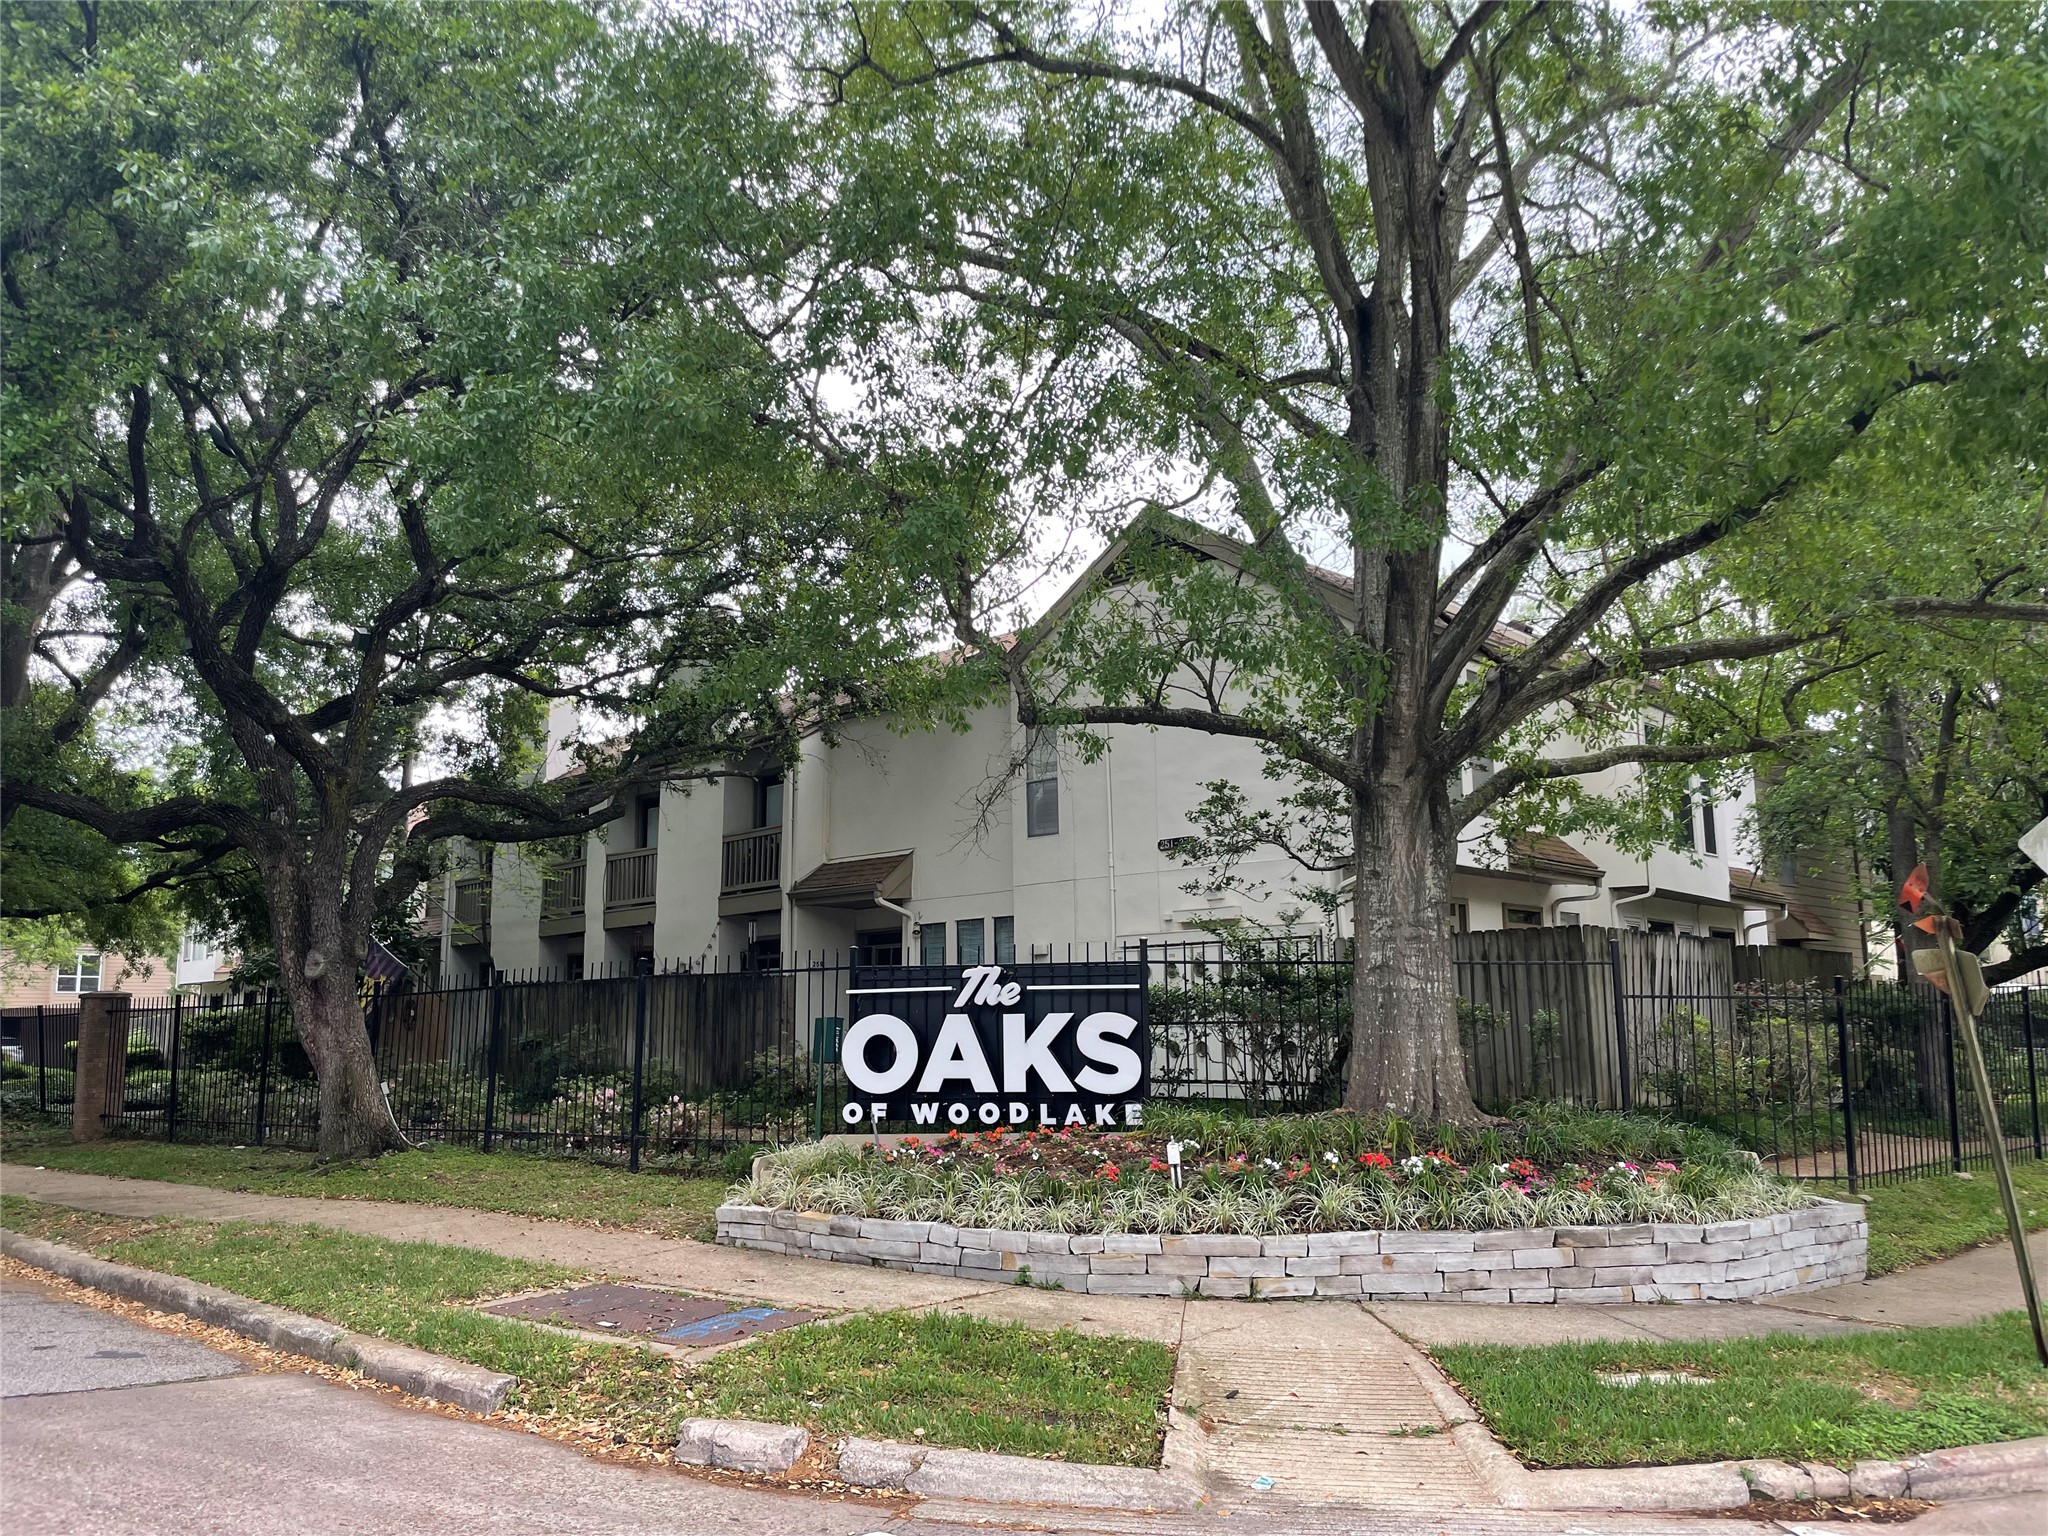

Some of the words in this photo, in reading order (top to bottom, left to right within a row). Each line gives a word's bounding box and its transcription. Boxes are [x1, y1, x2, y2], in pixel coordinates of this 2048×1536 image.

[953, 965, 1021, 1008] The
[841, 1011, 1142, 1095] OAKS
[842, 1102, 888, 1124] OF
[910, 1102, 1143, 1125] WOODLAKE
